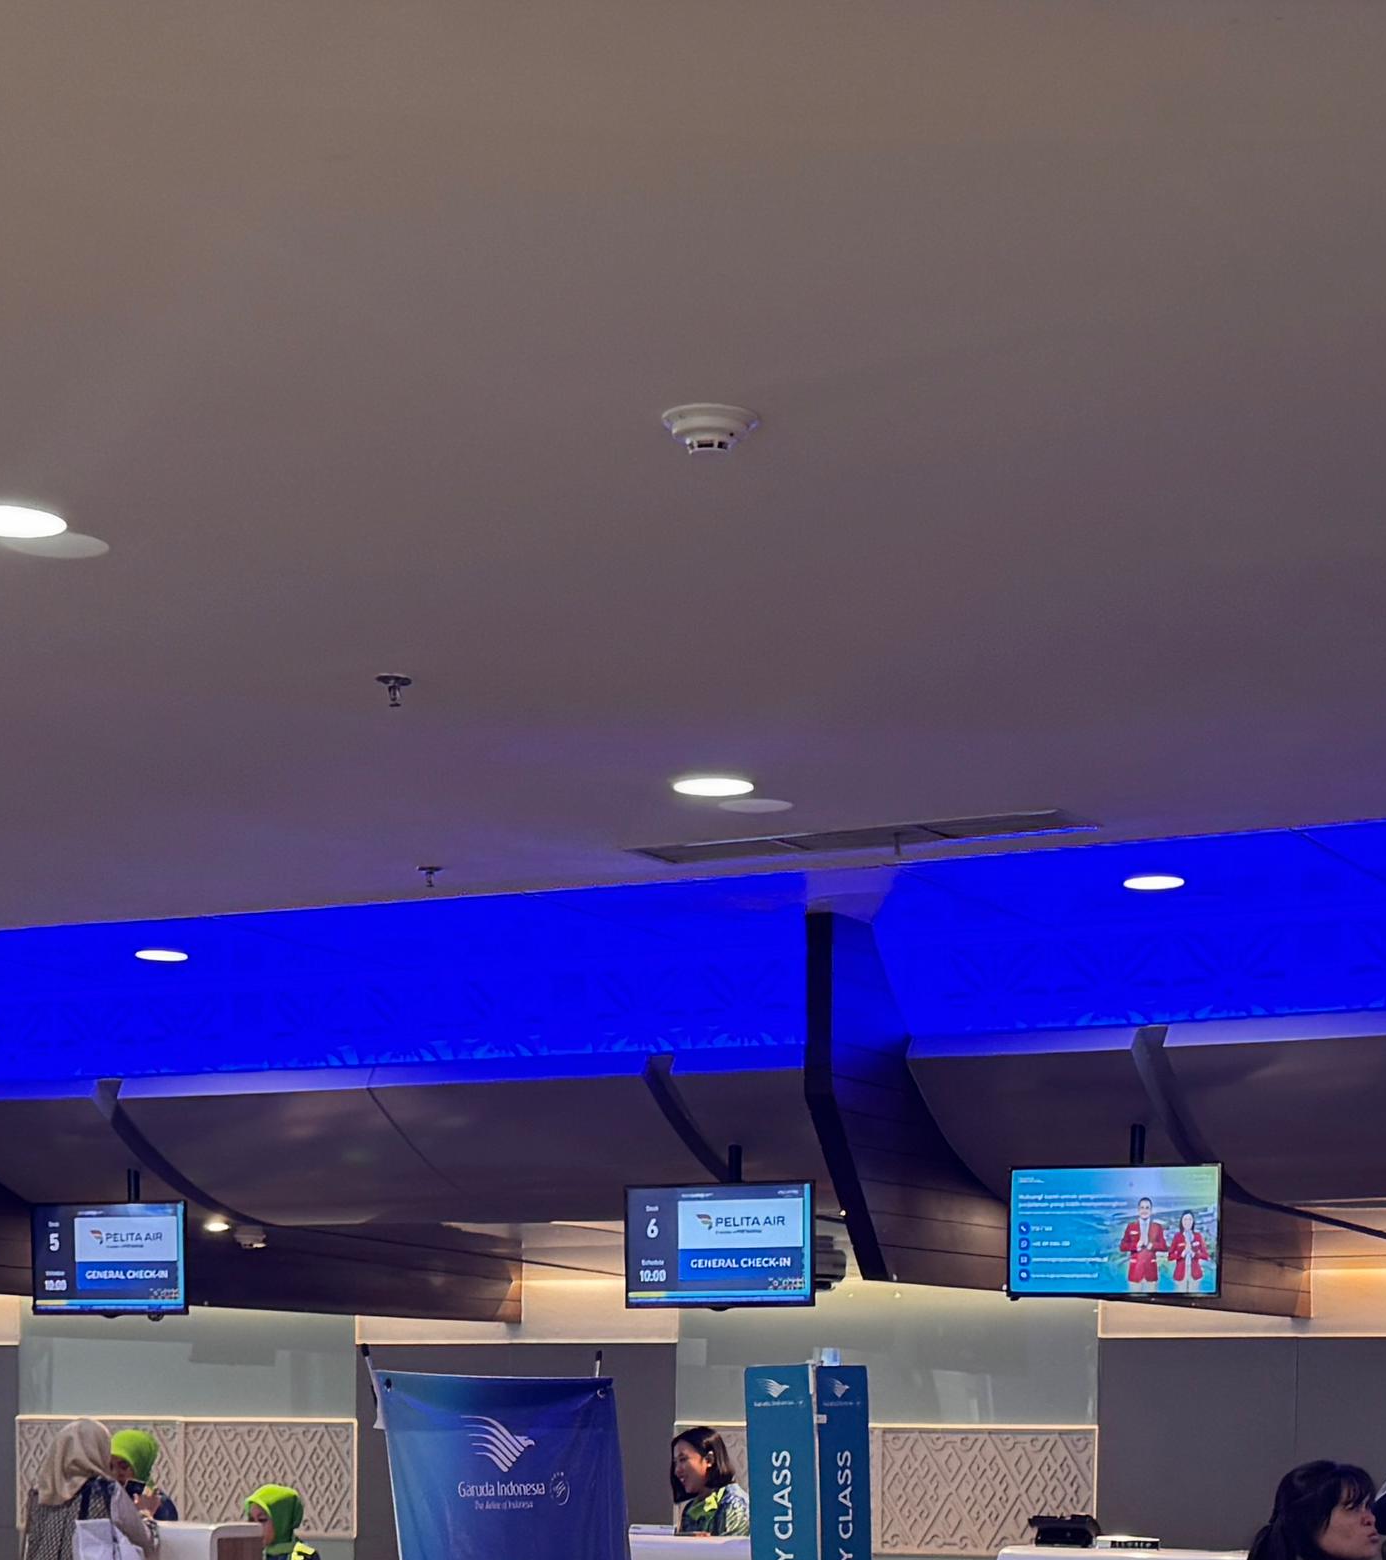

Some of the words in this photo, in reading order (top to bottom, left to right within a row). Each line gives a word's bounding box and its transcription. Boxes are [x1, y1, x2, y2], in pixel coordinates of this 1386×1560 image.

[646, 1218, 659, 1239] 6
[715, 1216, 760, 1227] PELITA
[763, 1215, 785, 1226] AIR
[49, 1233, 60, 1251] 5
[105, 1232, 142, 1242] PELITA
[144, 1231, 163, 1242] AIR
[690, 1258, 739, 1269] GENERAL
[740, 1257, 791, 1268] CHECK-IN
[639, 1269, 667, 1283] 10:00
[458, 1482, 495, 1498] Garuda
[496, 1481, 546, 1497] Indonesia
[771, 1450, 793, 1541] CLASS
[836, 1450, 854, 1540] CLASS
